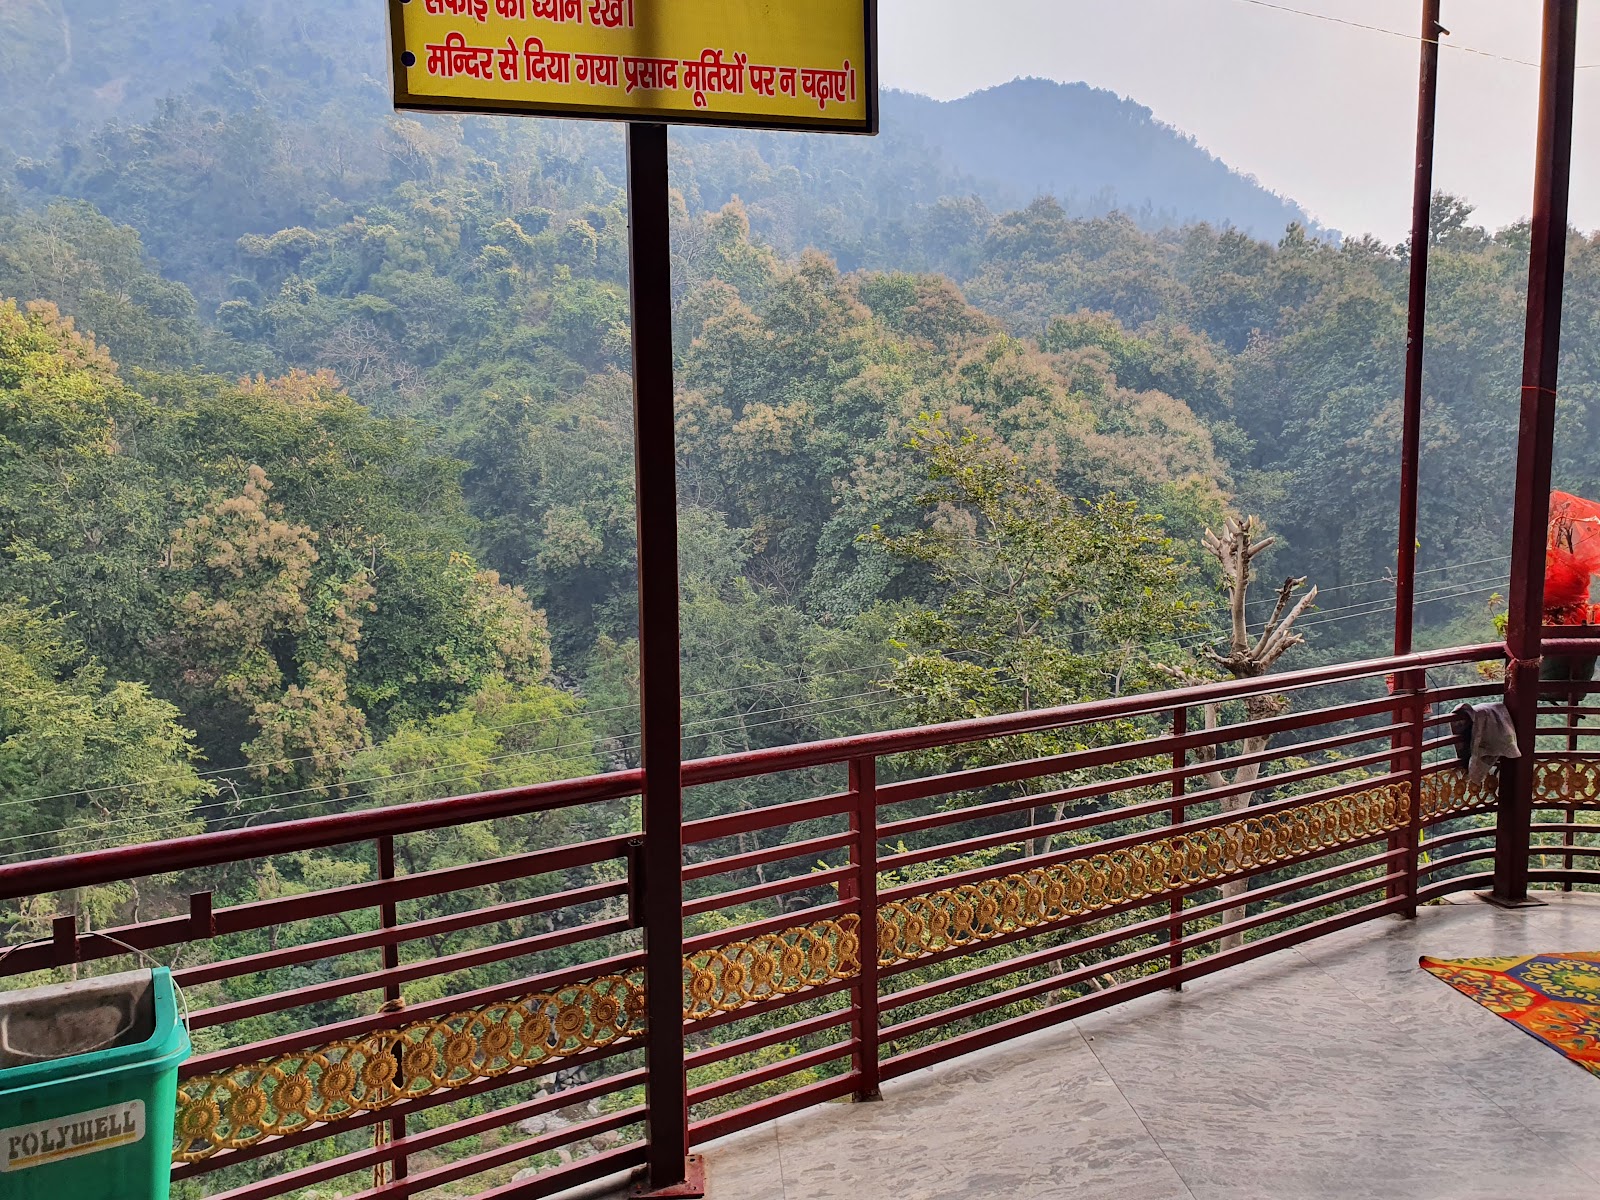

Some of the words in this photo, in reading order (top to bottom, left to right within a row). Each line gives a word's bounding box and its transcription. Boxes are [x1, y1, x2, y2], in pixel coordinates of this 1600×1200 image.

[425, 32, 494, 80] मन्दिर
[497, 37, 519, 81] से
[523, 37, 571, 83] दिया
[574, 54, 619, 86] गया
[622, 56, 679, 94] प्रसाद
[682, 48, 747, 107] मूर्तियों
[748, 65, 776, 96] पर
[779, 67, 797, 97] न
[8, 1110, 137, 1160] POLYWELL
